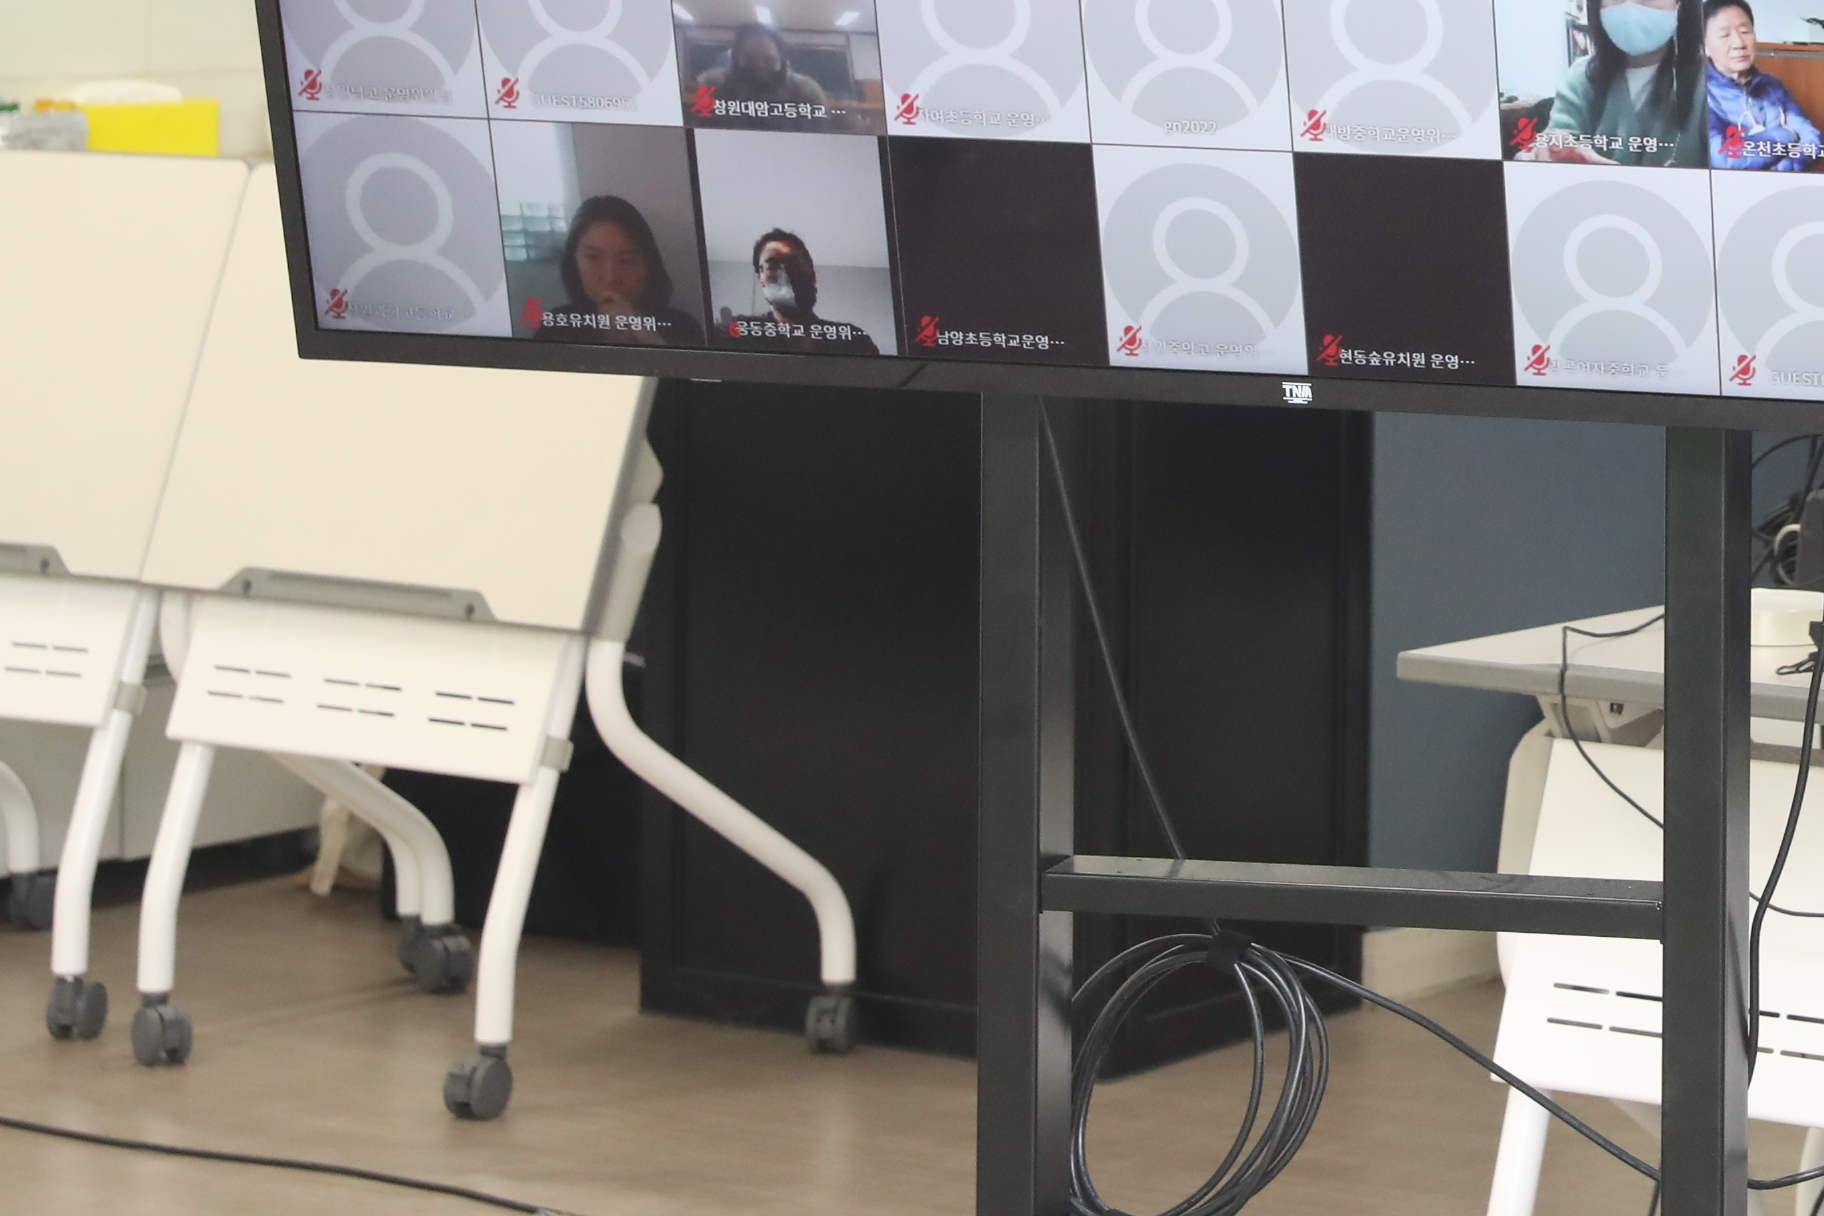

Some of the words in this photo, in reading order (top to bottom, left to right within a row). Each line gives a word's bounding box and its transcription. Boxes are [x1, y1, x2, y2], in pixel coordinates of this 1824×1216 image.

[713, 98, 828, 119] 창원대암고등학교
[1163, 119, 1218, 136] gn2022
[1534, 132, 1624, 152] 용지초등학교
[541, 312, 611, 330] 용호유치원
[1338, 348, 1426, 368] 현동숲유치원
